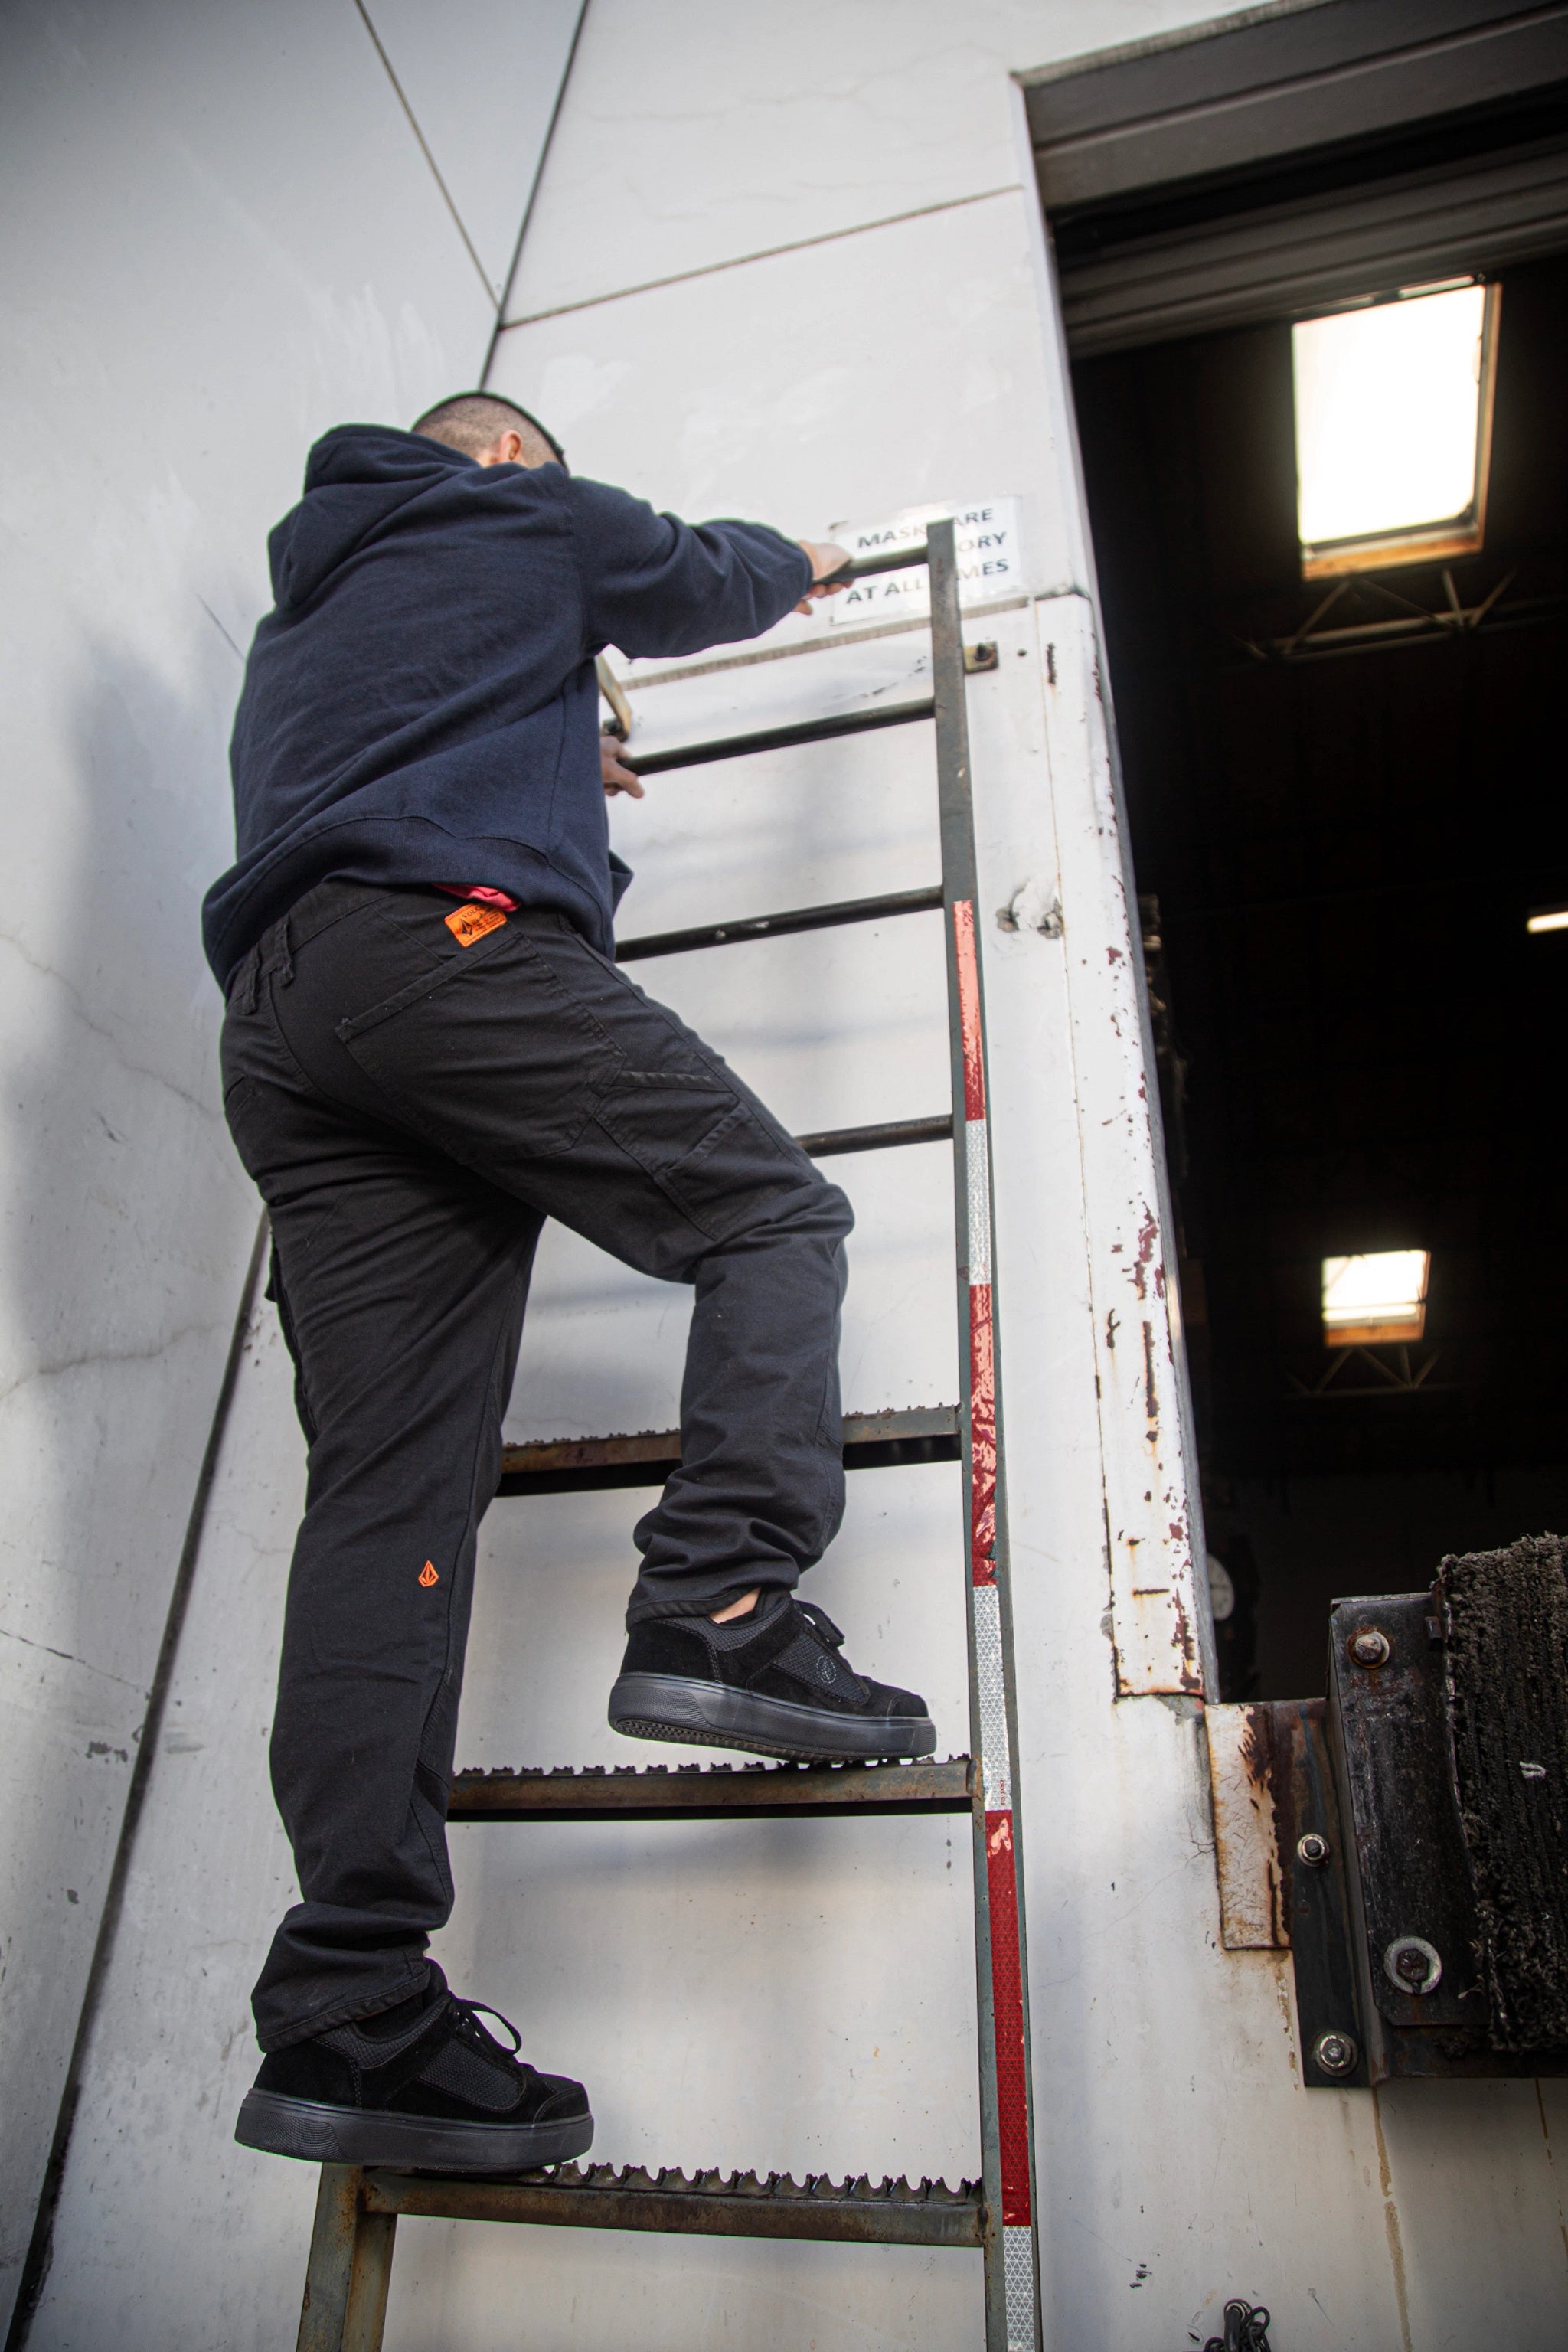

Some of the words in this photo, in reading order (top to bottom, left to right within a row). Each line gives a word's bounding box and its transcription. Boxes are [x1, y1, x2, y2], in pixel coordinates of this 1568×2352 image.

[858, 525, 927, 548] MASK
[845, 585, 878, 605] AT
[884, 578, 924, 596] ALL
[956, 558, 1010, 580] MES
